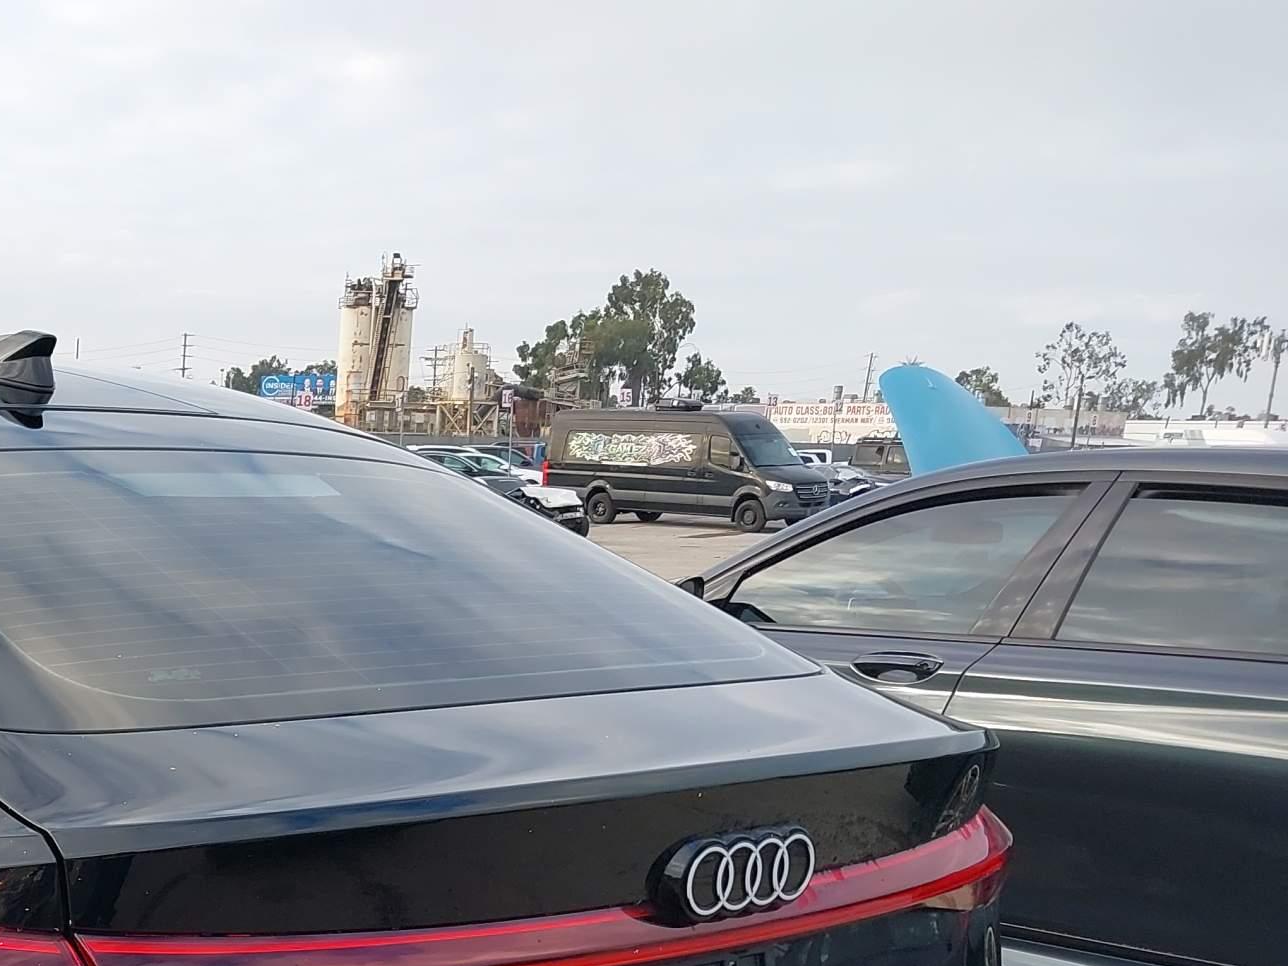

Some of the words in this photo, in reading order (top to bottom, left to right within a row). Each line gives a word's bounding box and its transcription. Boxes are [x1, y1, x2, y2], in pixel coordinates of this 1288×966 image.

[297, 395, 312, 407] 18
[621, 391, 632, 402] 15
[767, 396, 778, 407] 13
[774, 406, 793, 415] AUTO
[835, 402, 843, 412] 12
